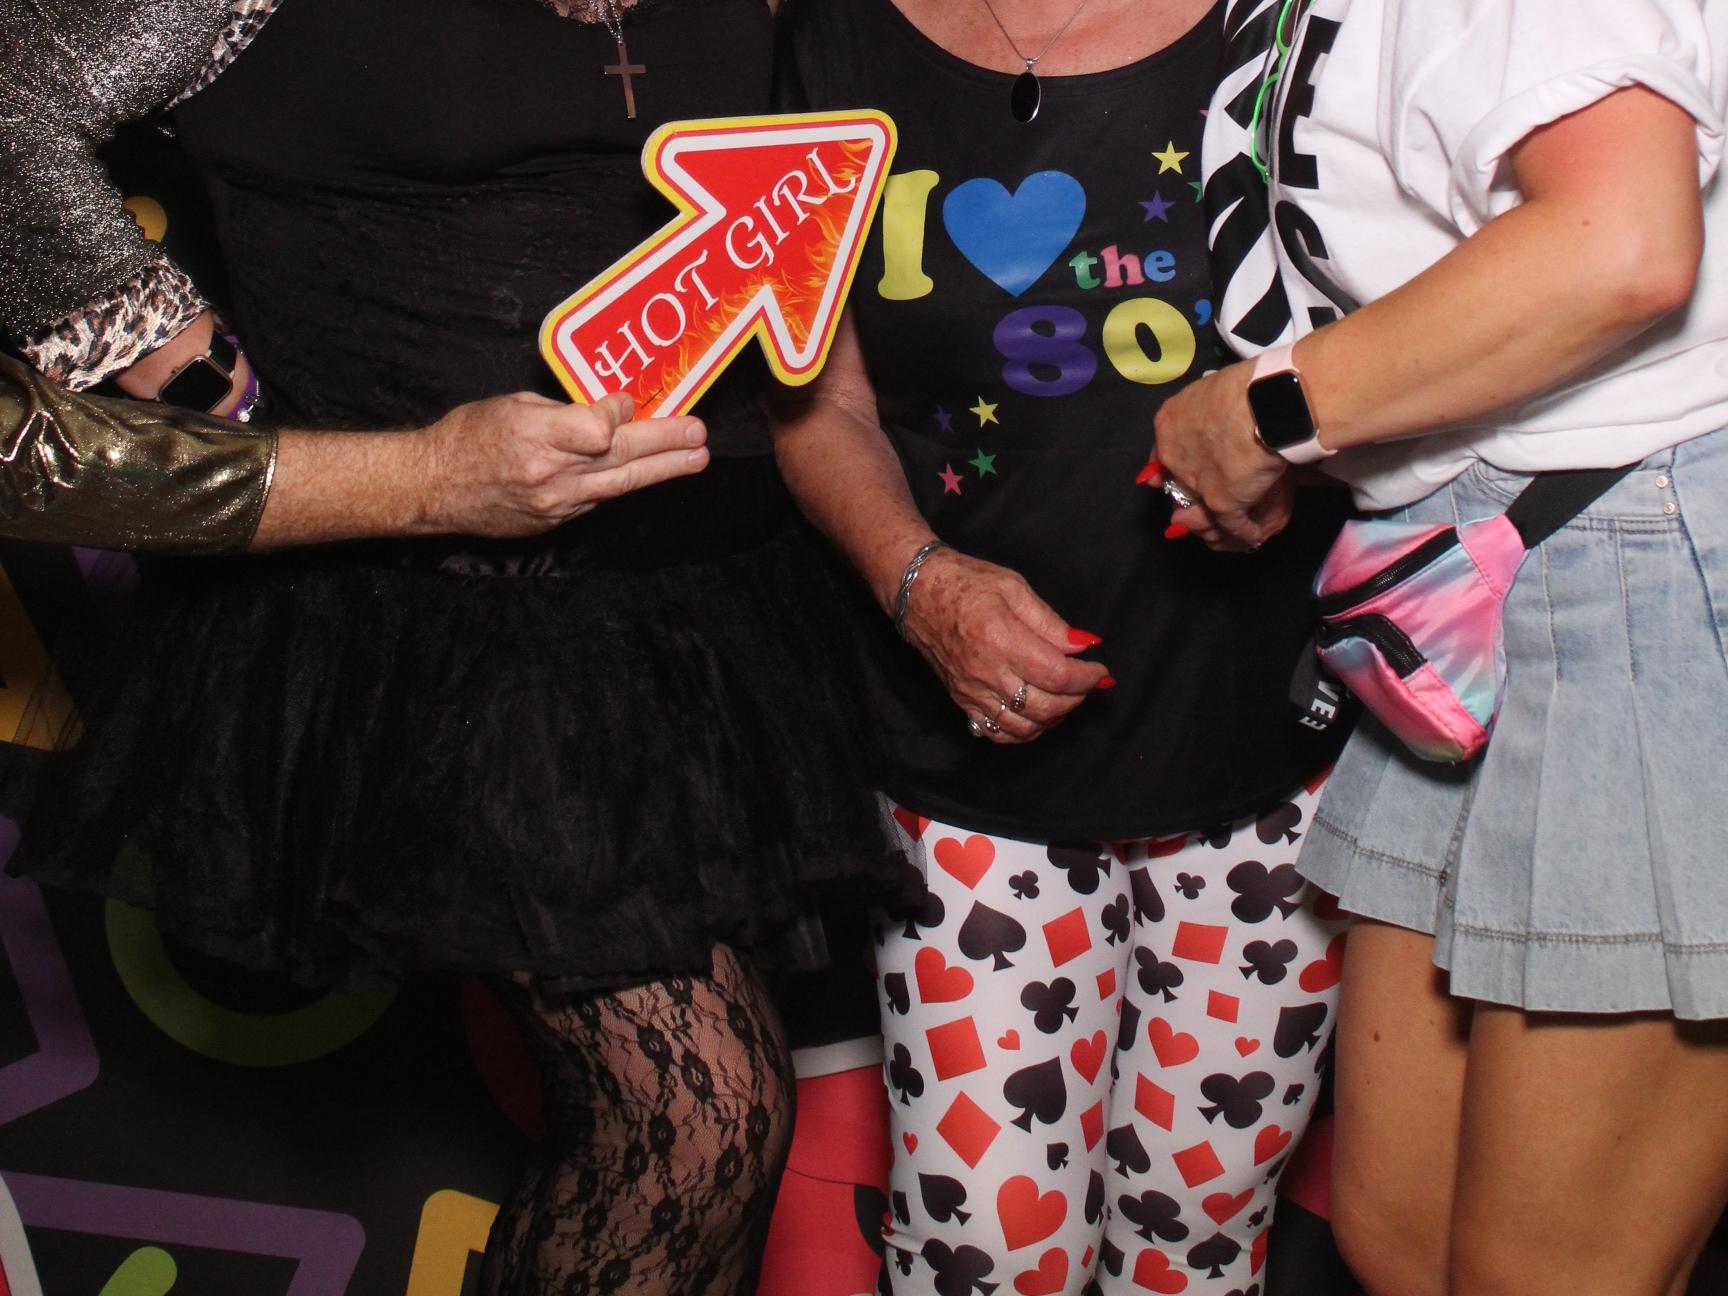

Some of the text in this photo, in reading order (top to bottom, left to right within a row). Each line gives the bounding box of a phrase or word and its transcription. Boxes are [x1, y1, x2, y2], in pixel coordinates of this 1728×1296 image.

[594, 147, 857, 391] HOT GIRL
[878, 169, 940, 301] I
[1068, 244, 1177, 290] the
[993, 296, 1222, 398] 80'
